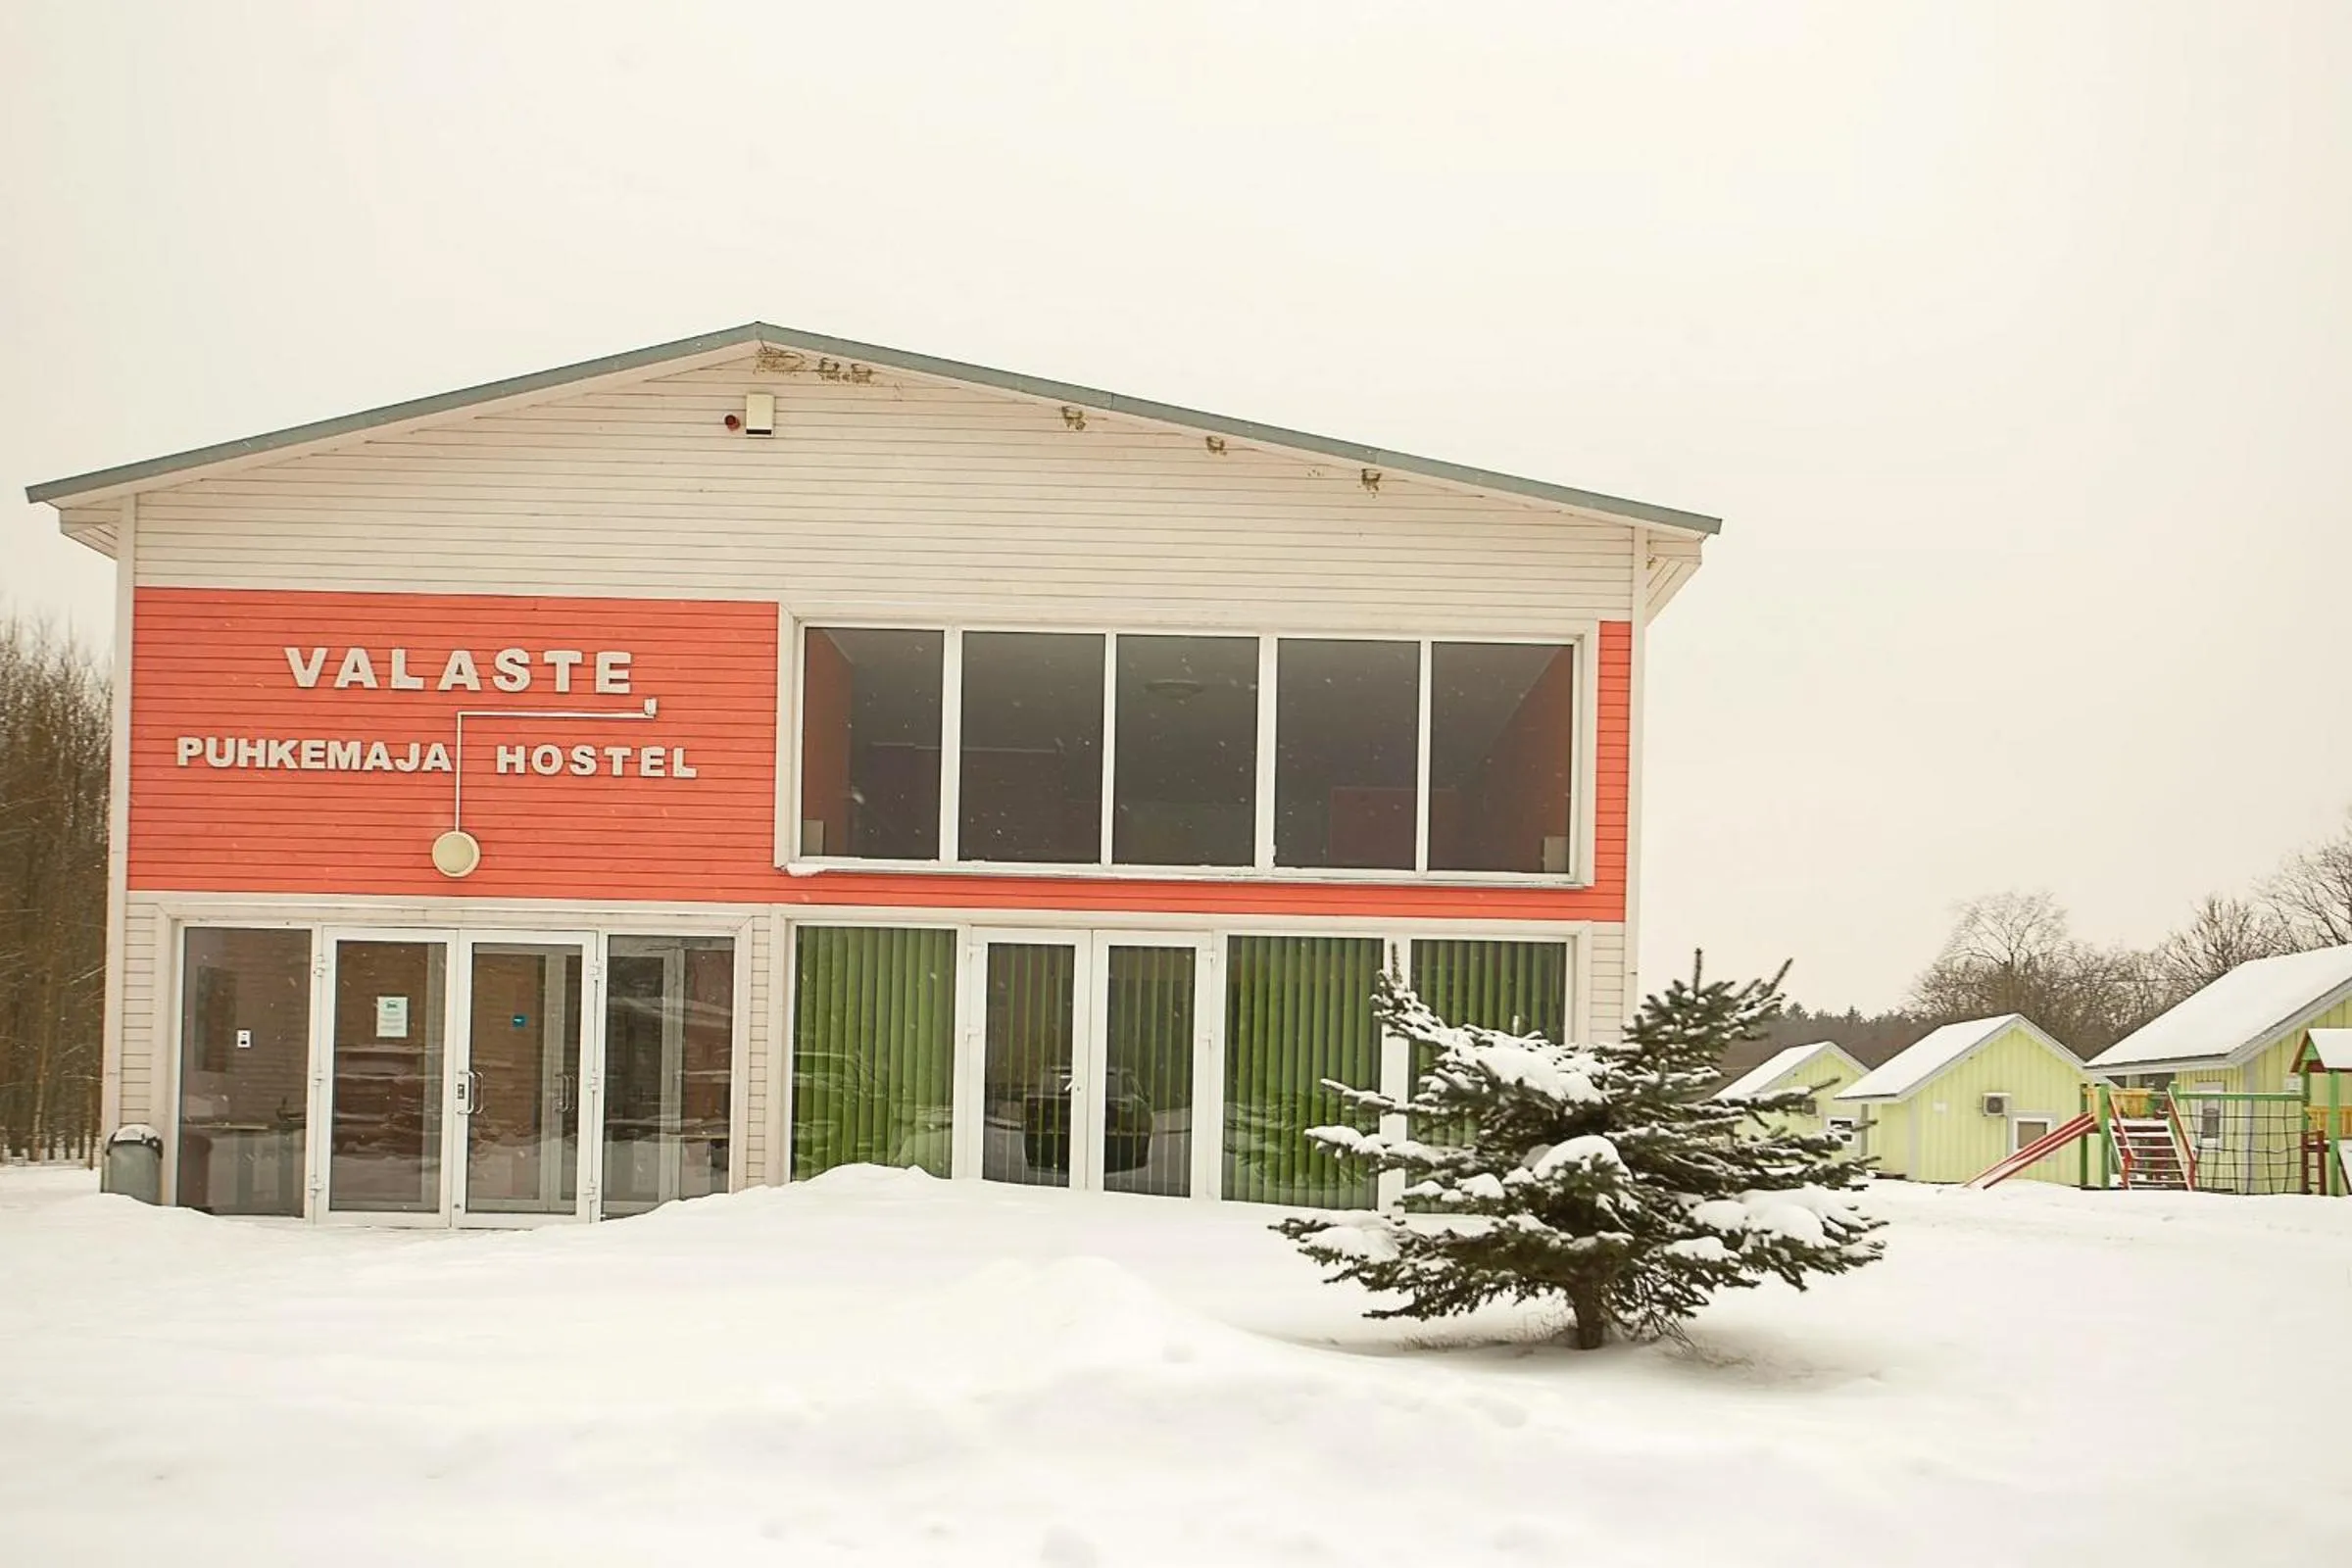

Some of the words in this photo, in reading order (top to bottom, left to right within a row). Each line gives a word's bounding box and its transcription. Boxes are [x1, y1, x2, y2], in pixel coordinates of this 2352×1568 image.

[284, 646, 633, 694] VALASTE
[176, 736, 454, 773] PUHKEMAJA
[496, 745, 698, 779] HOSTEL
